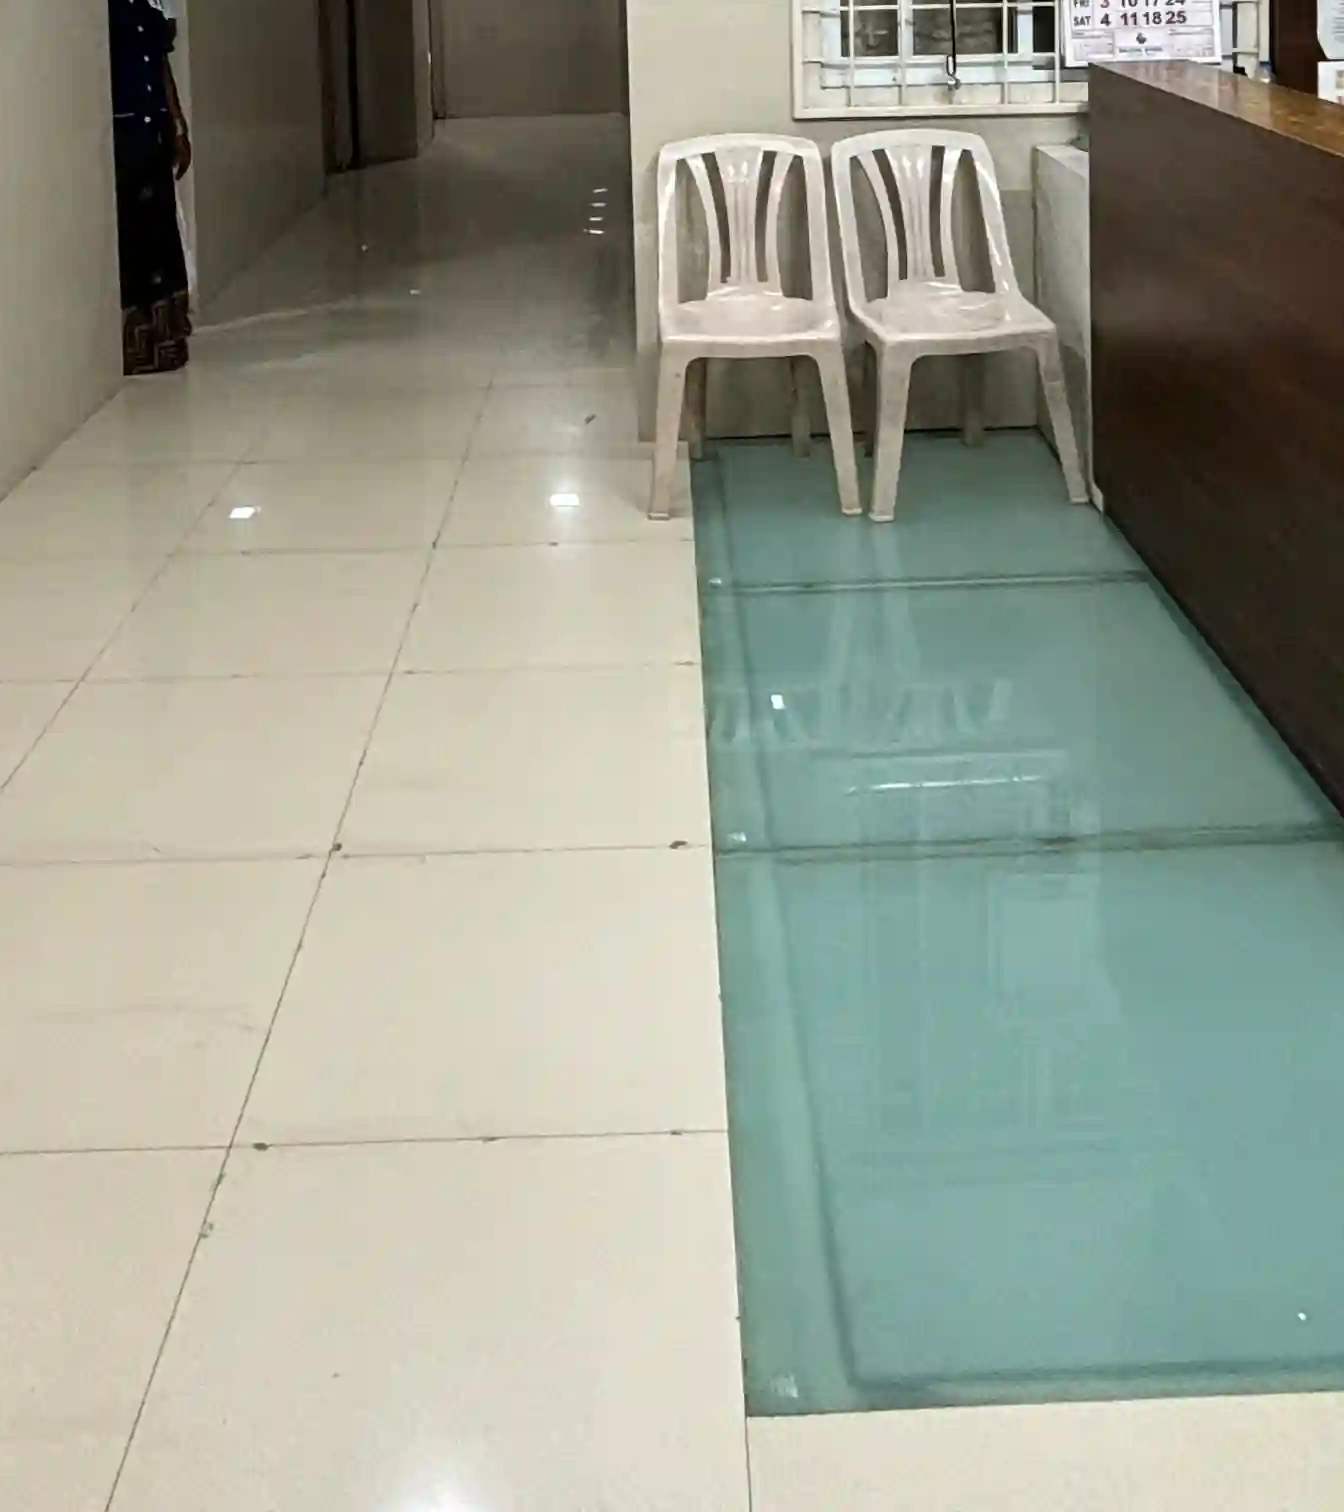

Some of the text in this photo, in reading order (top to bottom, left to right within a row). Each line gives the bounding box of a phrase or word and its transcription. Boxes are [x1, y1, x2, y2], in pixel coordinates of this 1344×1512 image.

[1074, 11, 1187, 26] SAT 4 11 18 25
